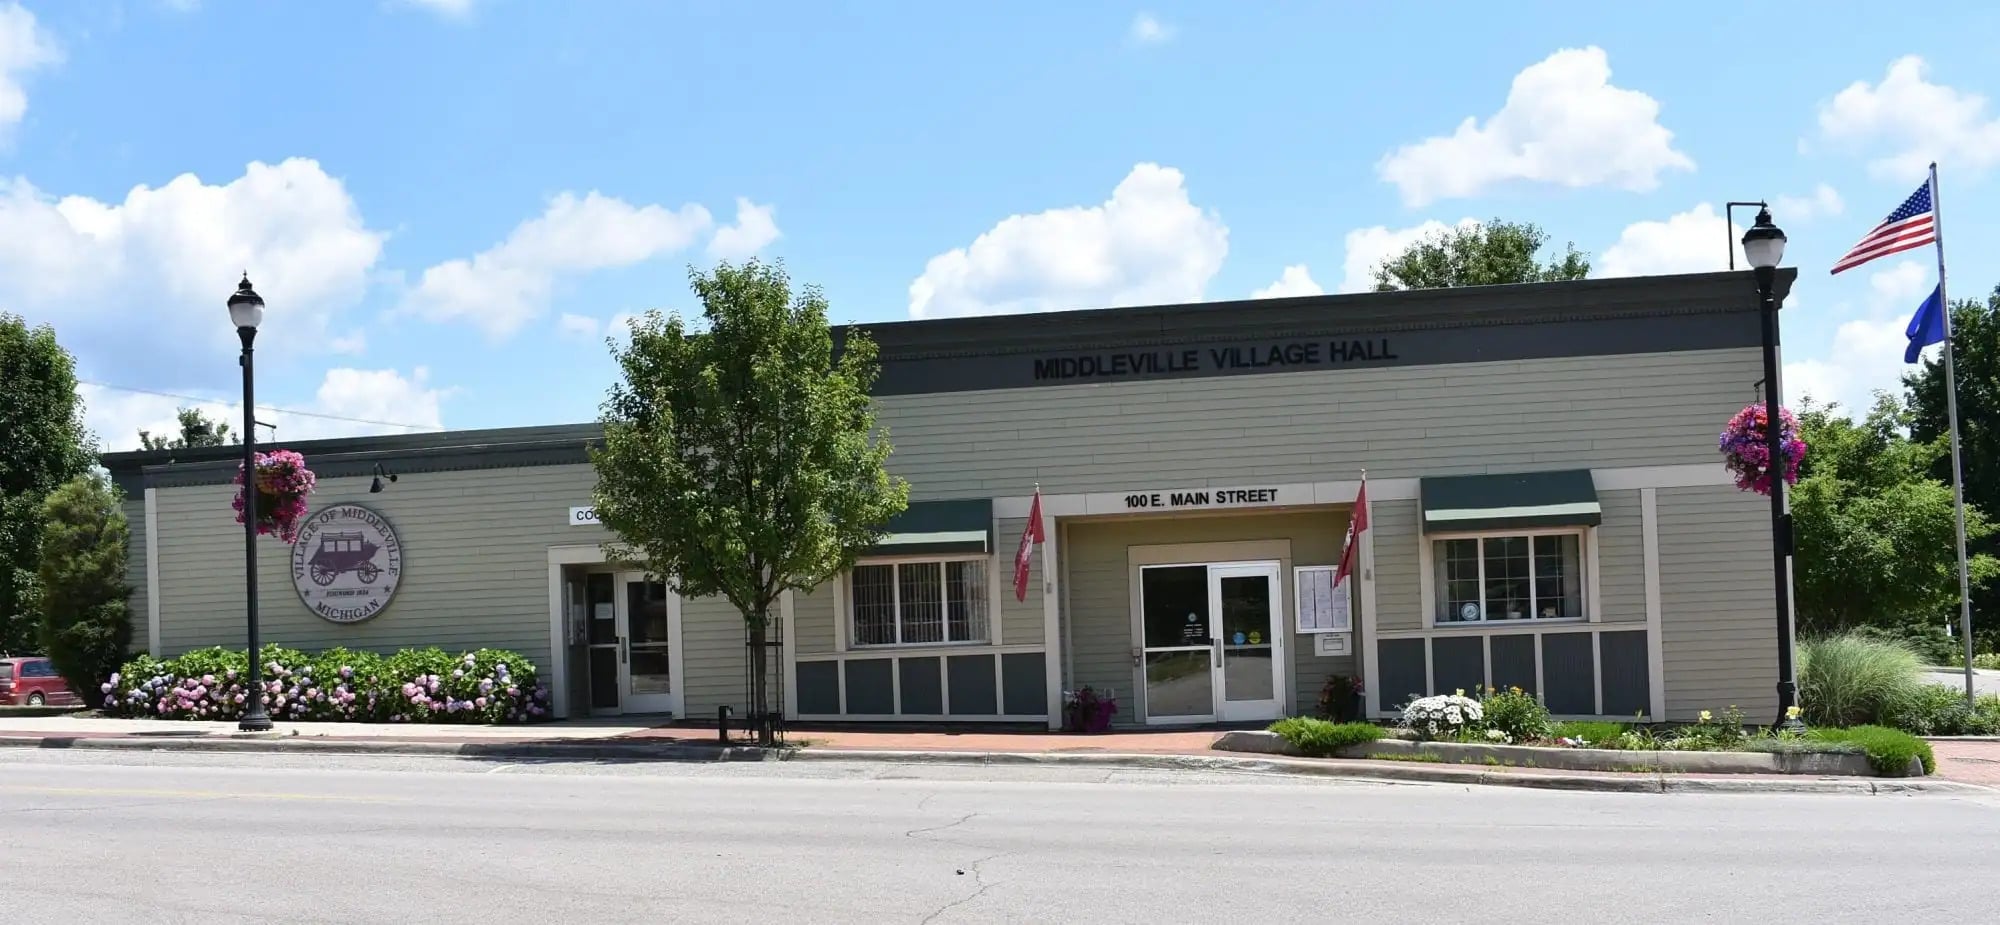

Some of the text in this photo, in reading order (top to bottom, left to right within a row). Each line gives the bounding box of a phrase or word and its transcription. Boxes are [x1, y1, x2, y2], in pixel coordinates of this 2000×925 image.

[1034, 338, 1398, 380] MIDDLEVILLE VILLAGE HALL
[1125, 488, 1278, 508] 100 E. MAIN STREET
[294, 507, 399, 580] VILLAGE OF MIDDLEVILLE
[315, 599, 380, 620] MICHIGAN
